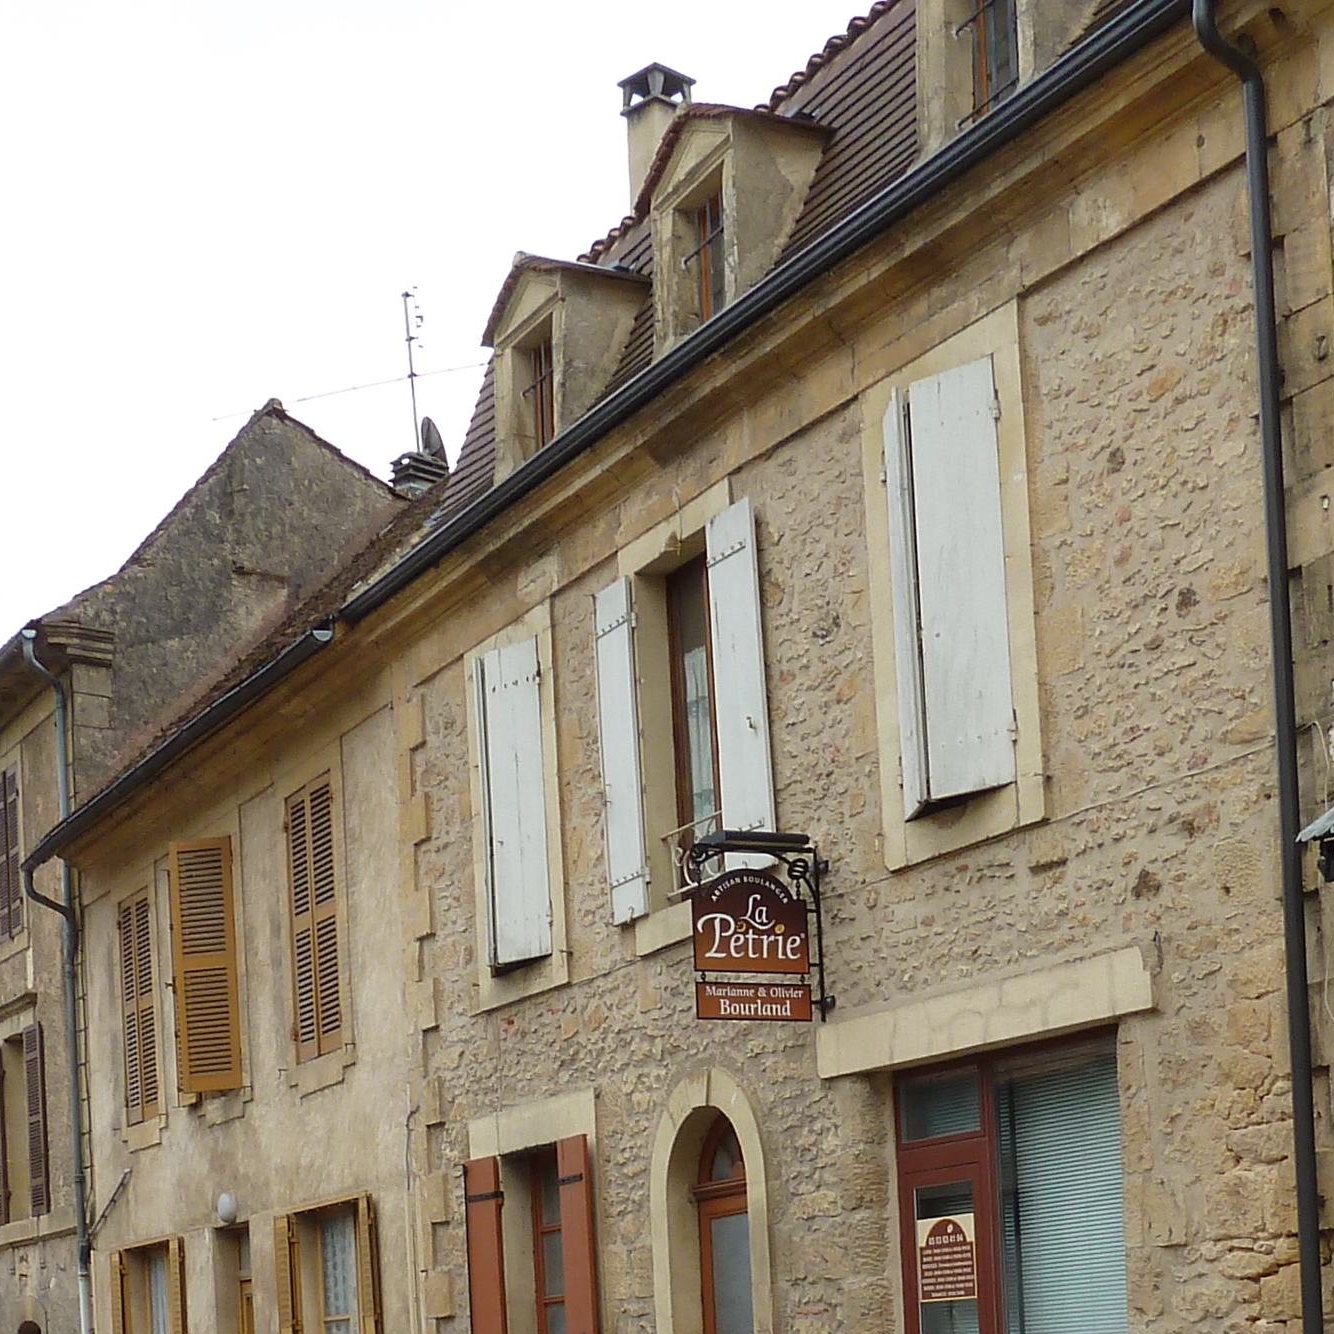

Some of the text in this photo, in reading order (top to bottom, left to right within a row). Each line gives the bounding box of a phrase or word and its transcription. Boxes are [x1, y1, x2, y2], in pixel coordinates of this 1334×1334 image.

[710, 875, 789, 904] ARTISAN BOULANGER
[739, 893, 776, 930] La
[705, 985, 804, 999] Marianne & Olivier
[719, 998, 792, 1017] Bourland
